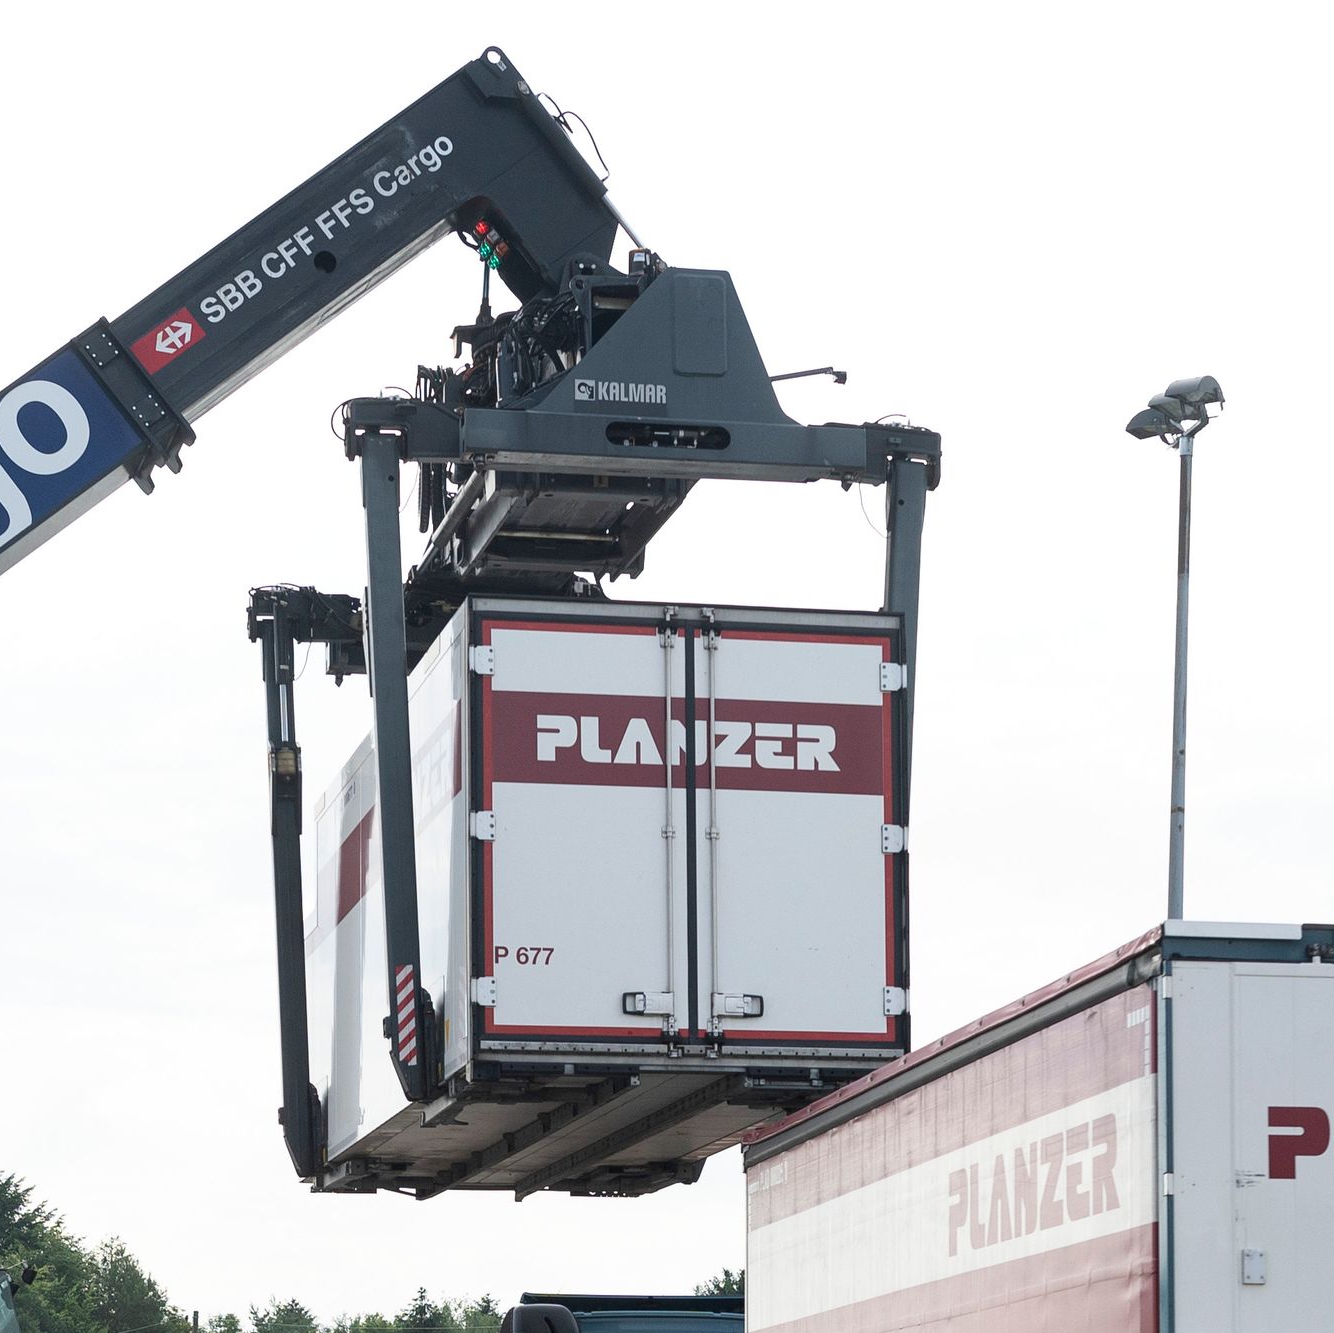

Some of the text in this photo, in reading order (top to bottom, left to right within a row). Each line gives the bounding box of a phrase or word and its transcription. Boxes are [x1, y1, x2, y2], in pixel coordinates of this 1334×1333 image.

[200, 135, 454, 323] SBB CFF FFS Cargo
[598, 381, 667, 404] KALMAR
[536, 714, 842, 772] PLANZER
[494, 946, 555, 965] P 677
[948, 1112, 1121, 1258] PLANZER
